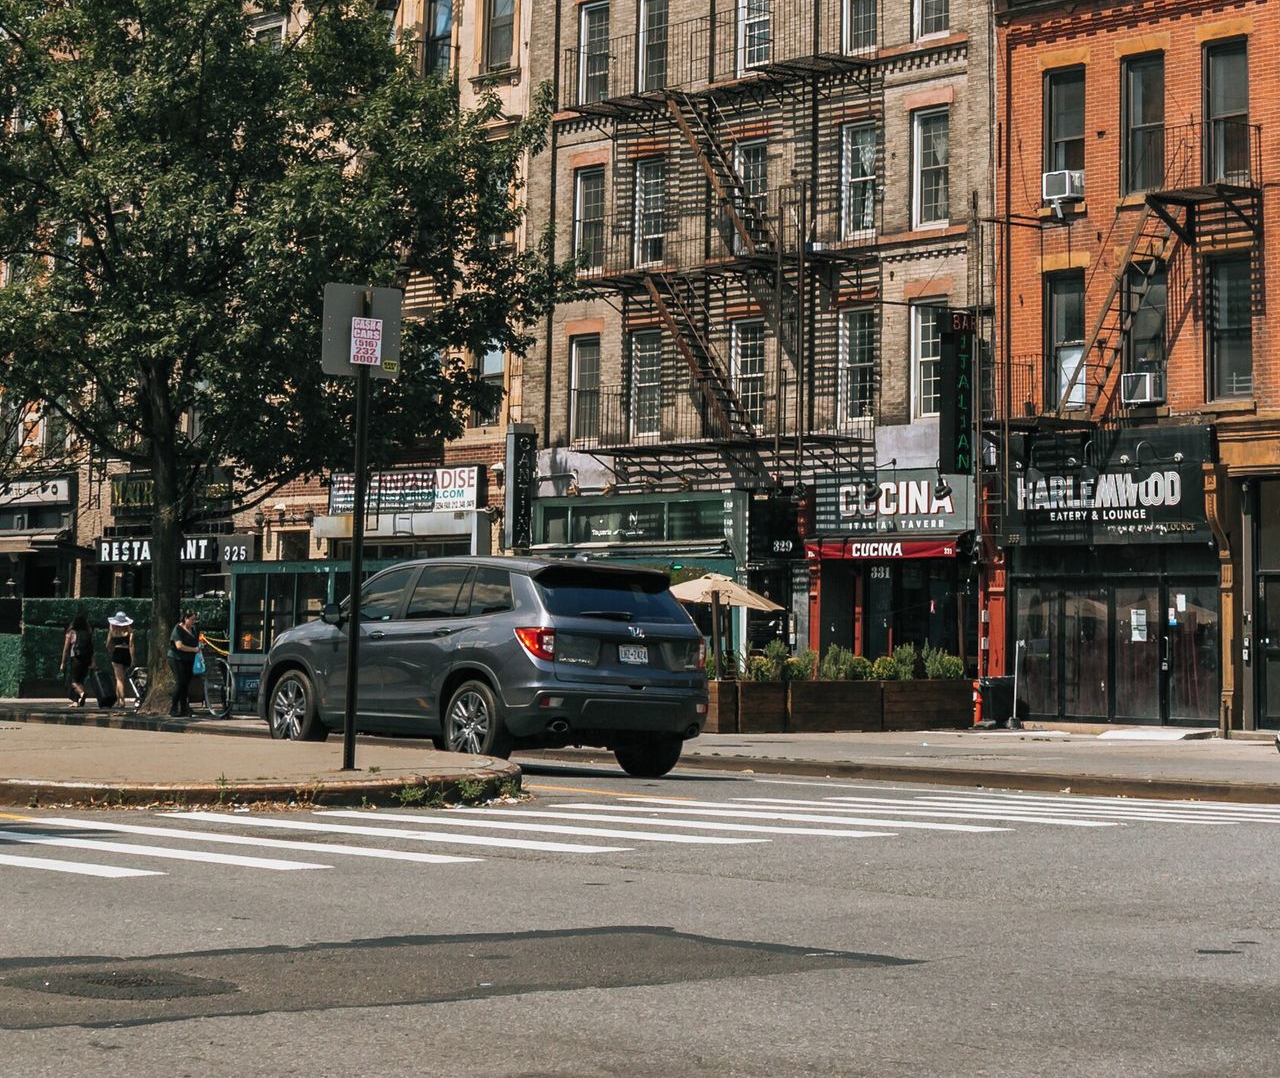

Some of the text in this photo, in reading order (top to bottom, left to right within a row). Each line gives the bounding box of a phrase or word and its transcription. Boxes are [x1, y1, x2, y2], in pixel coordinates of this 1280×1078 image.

[353, 328, 380, 341] CARS
[354, 339, 378, 348] (516)
[355, 347, 377, 356] 232
[352, 354, 379, 364] 0007
[1016, 470, 1182, 511] HARLEMWOOD
[838, 479, 956, 518] CUCINA
[1050, 508, 1147, 522] EATERY & LOUNGE
[900, 519, 946, 529] TAVERN
[100, 538, 208, 562] RESTANT
[223, 544, 247, 562] 325
[773, 540, 793, 553] 329
[851, 541, 904, 557] CUCINA
[870, 565, 891, 579] 331
